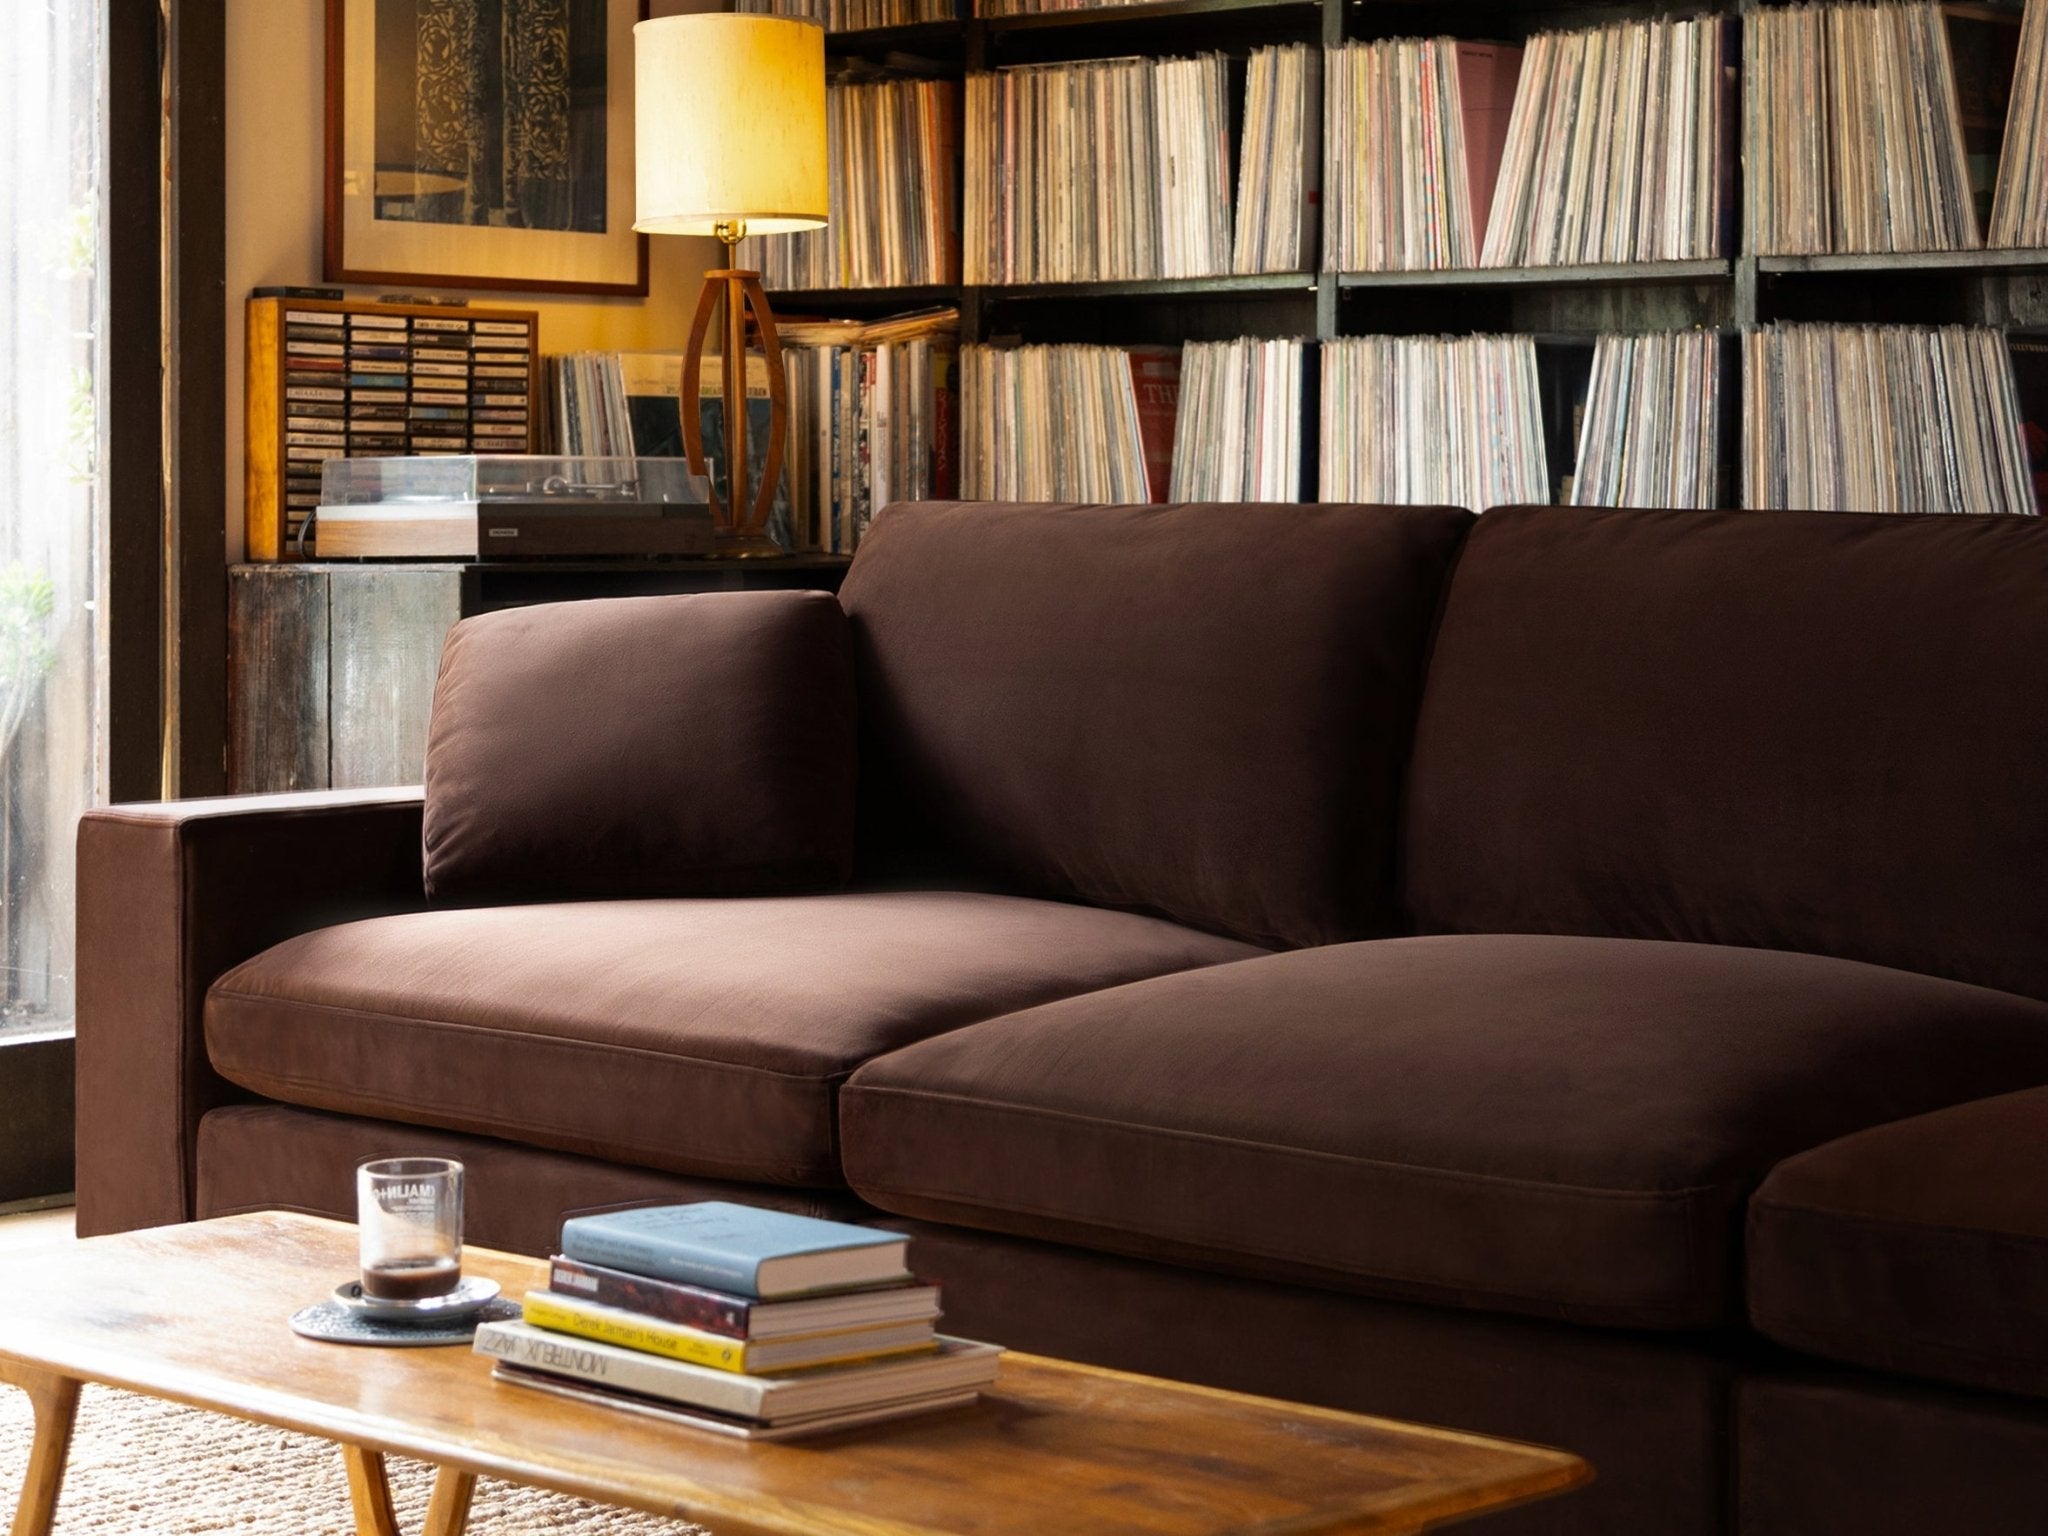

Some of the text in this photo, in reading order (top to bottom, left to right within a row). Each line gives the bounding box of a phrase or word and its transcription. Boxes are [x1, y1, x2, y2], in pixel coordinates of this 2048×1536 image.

[573, 1312, 601, 1330] Derek
[603, 1320, 644, 1343] Jarman's
[646, 1331, 678, 1349] House
[482, 1330, 607, 1375] MONTREUX JAZZ
